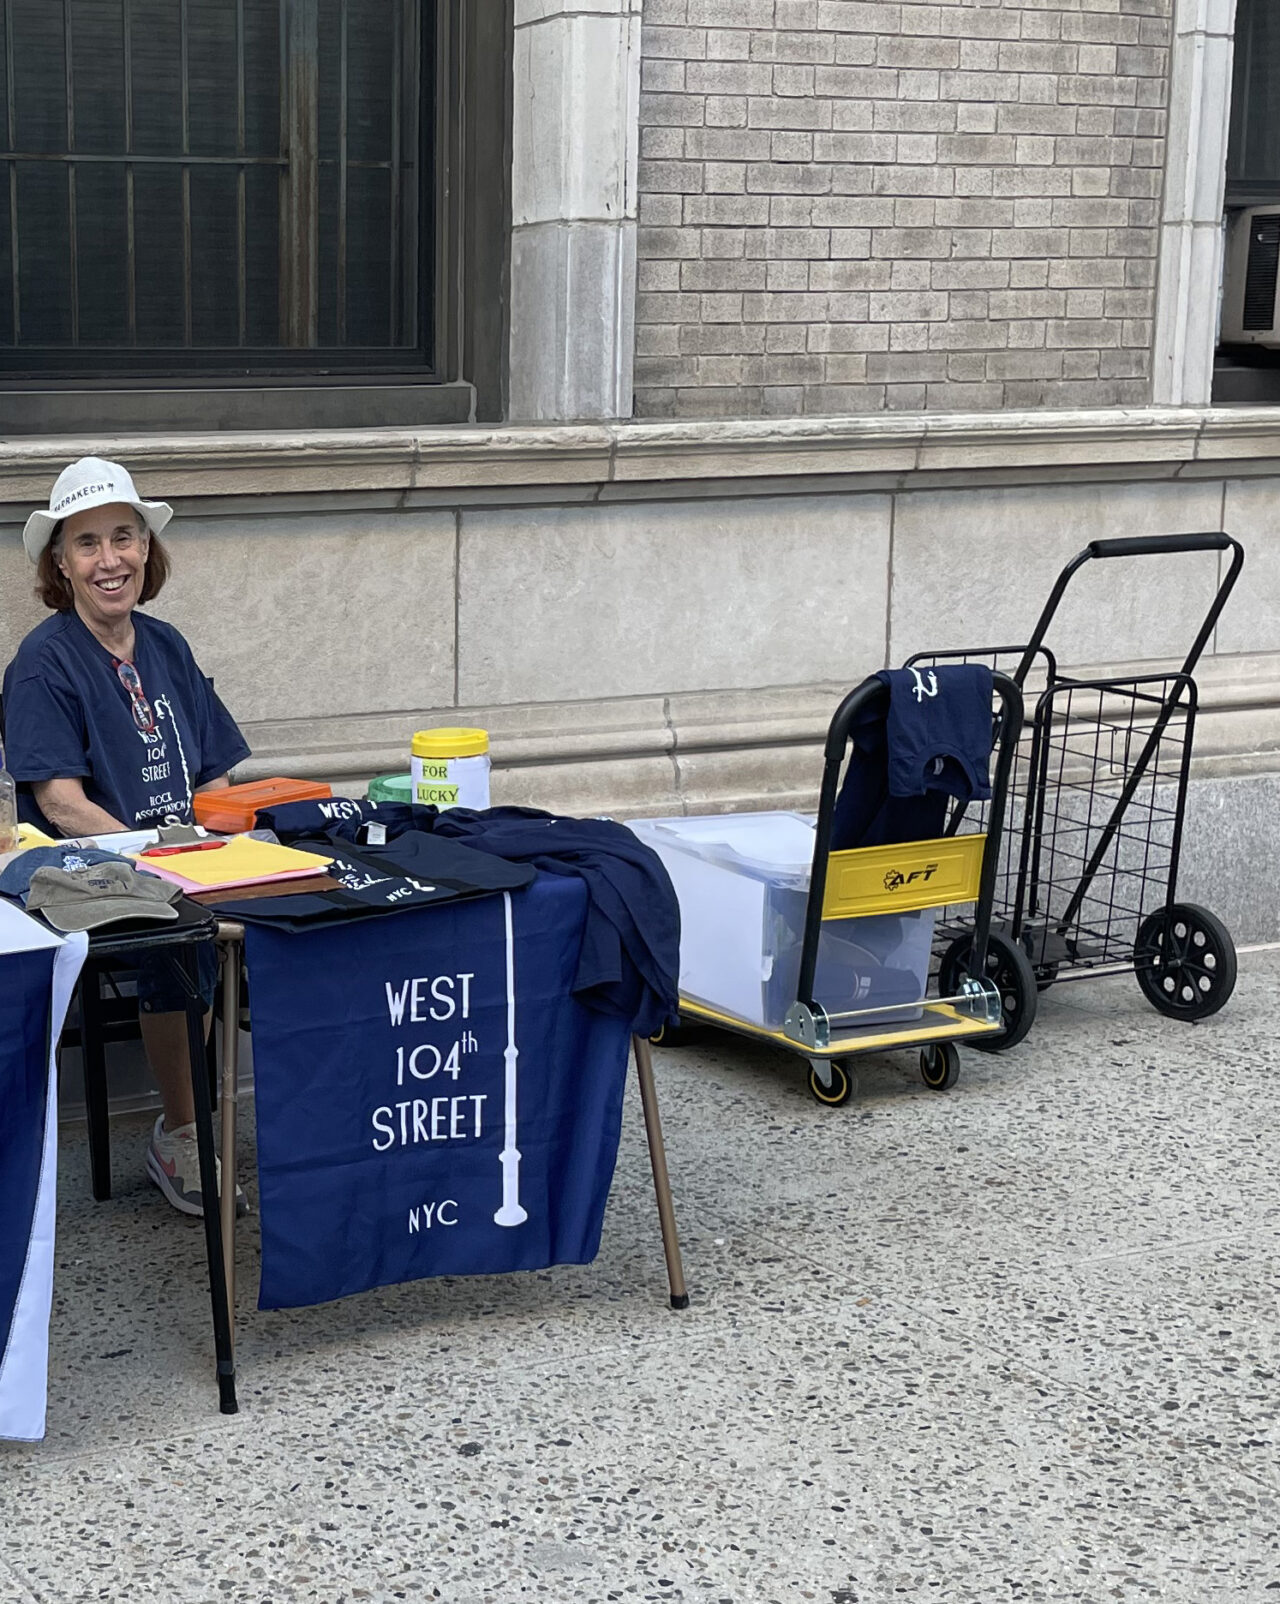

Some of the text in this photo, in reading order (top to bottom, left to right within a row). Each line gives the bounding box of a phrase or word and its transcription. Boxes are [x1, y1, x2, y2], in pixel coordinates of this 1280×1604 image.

[422, 765, 448, 779] FOR
[417, 787, 459, 802] LUCKY
[888, 869, 937, 886] AFT
[386, 887, 412, 902] NYC
[385, 973, 474, 1027] WEST
[396, 1030, 478, 1085] 104th
[372, 1094, 487, 1151] STREET
[409, 1200, 458, 1234] NYC
